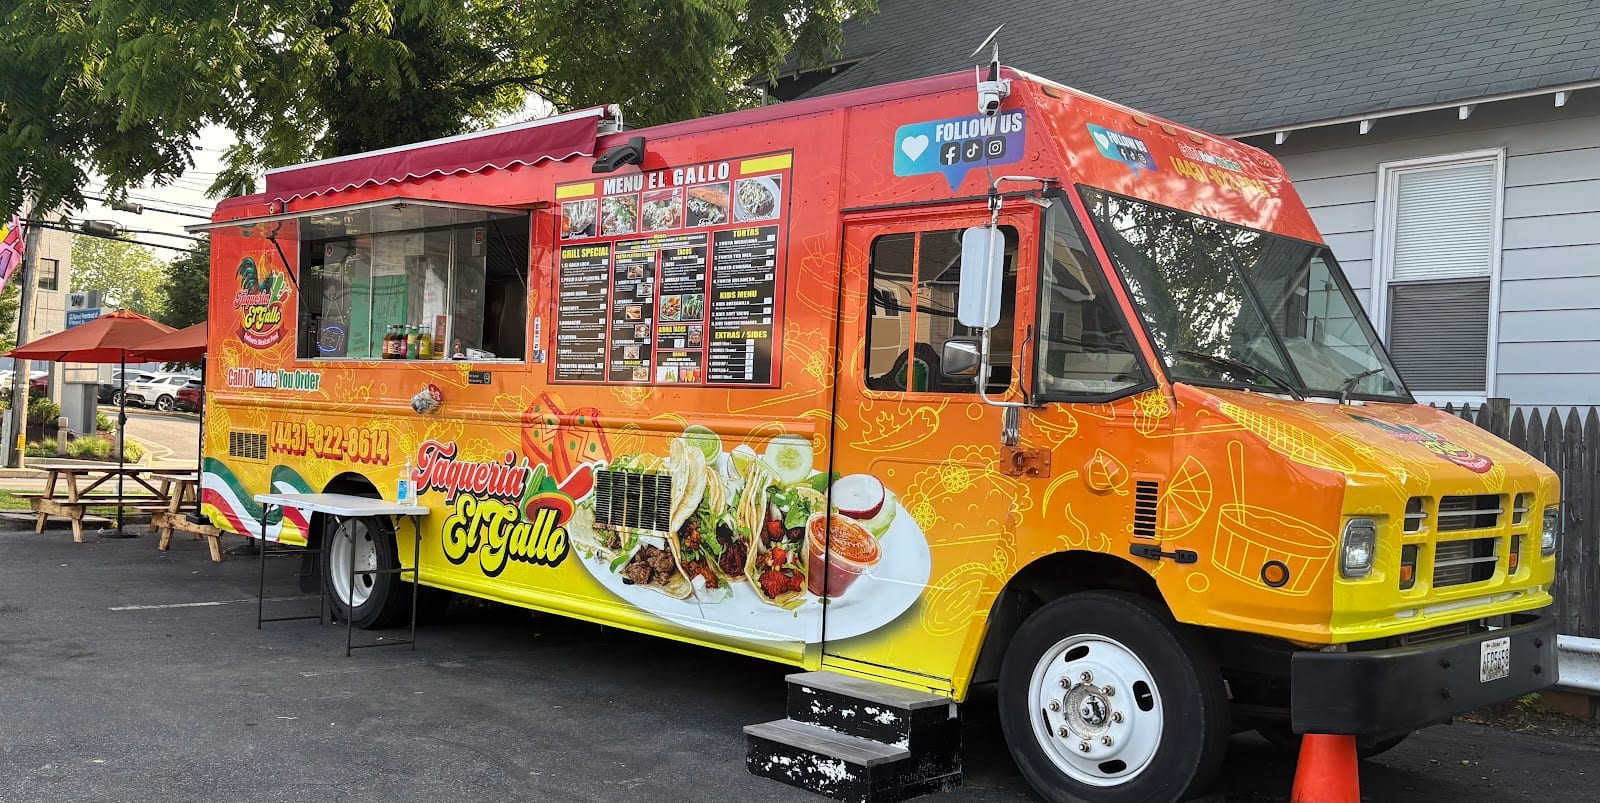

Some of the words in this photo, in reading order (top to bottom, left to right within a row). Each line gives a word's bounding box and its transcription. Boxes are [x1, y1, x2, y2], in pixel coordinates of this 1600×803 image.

[935, 117, 997, 143] FOLLOW
[1001, 112, 1023, 134] US
[1106, 131, 1136, 149] FOLLOW
[603, 174, 644, 195] MENU
[648, 172, 666, 189] EL
[673, 162, 731, 186] GALLO
[733, 228, 760, 238] TORTAS
[562, 249, 581, 259] GRILL
[581, 247, 609, 258] SPECIAL
[234, 287, 271, 309] Taqueria
[719, 291, 737, 300] KIDS
[737, 290, 758, 299] MENU
[244, 306, 258, 330] El
[256, 305, 282, 331] Gallo
[715, 331, 741, 339] EXTRAS
[228, 368, 242, 388] Call
[242, 368, 254, 388] To
[254, 369, 277, 389] Make
[278, 370, 293, 389] You
[293, 371, 320, 391] Order
[412, 440, 527, 505] Taqueria
[442, 493, 484, 566] El
[478, 499, 570, 577] Gallo
